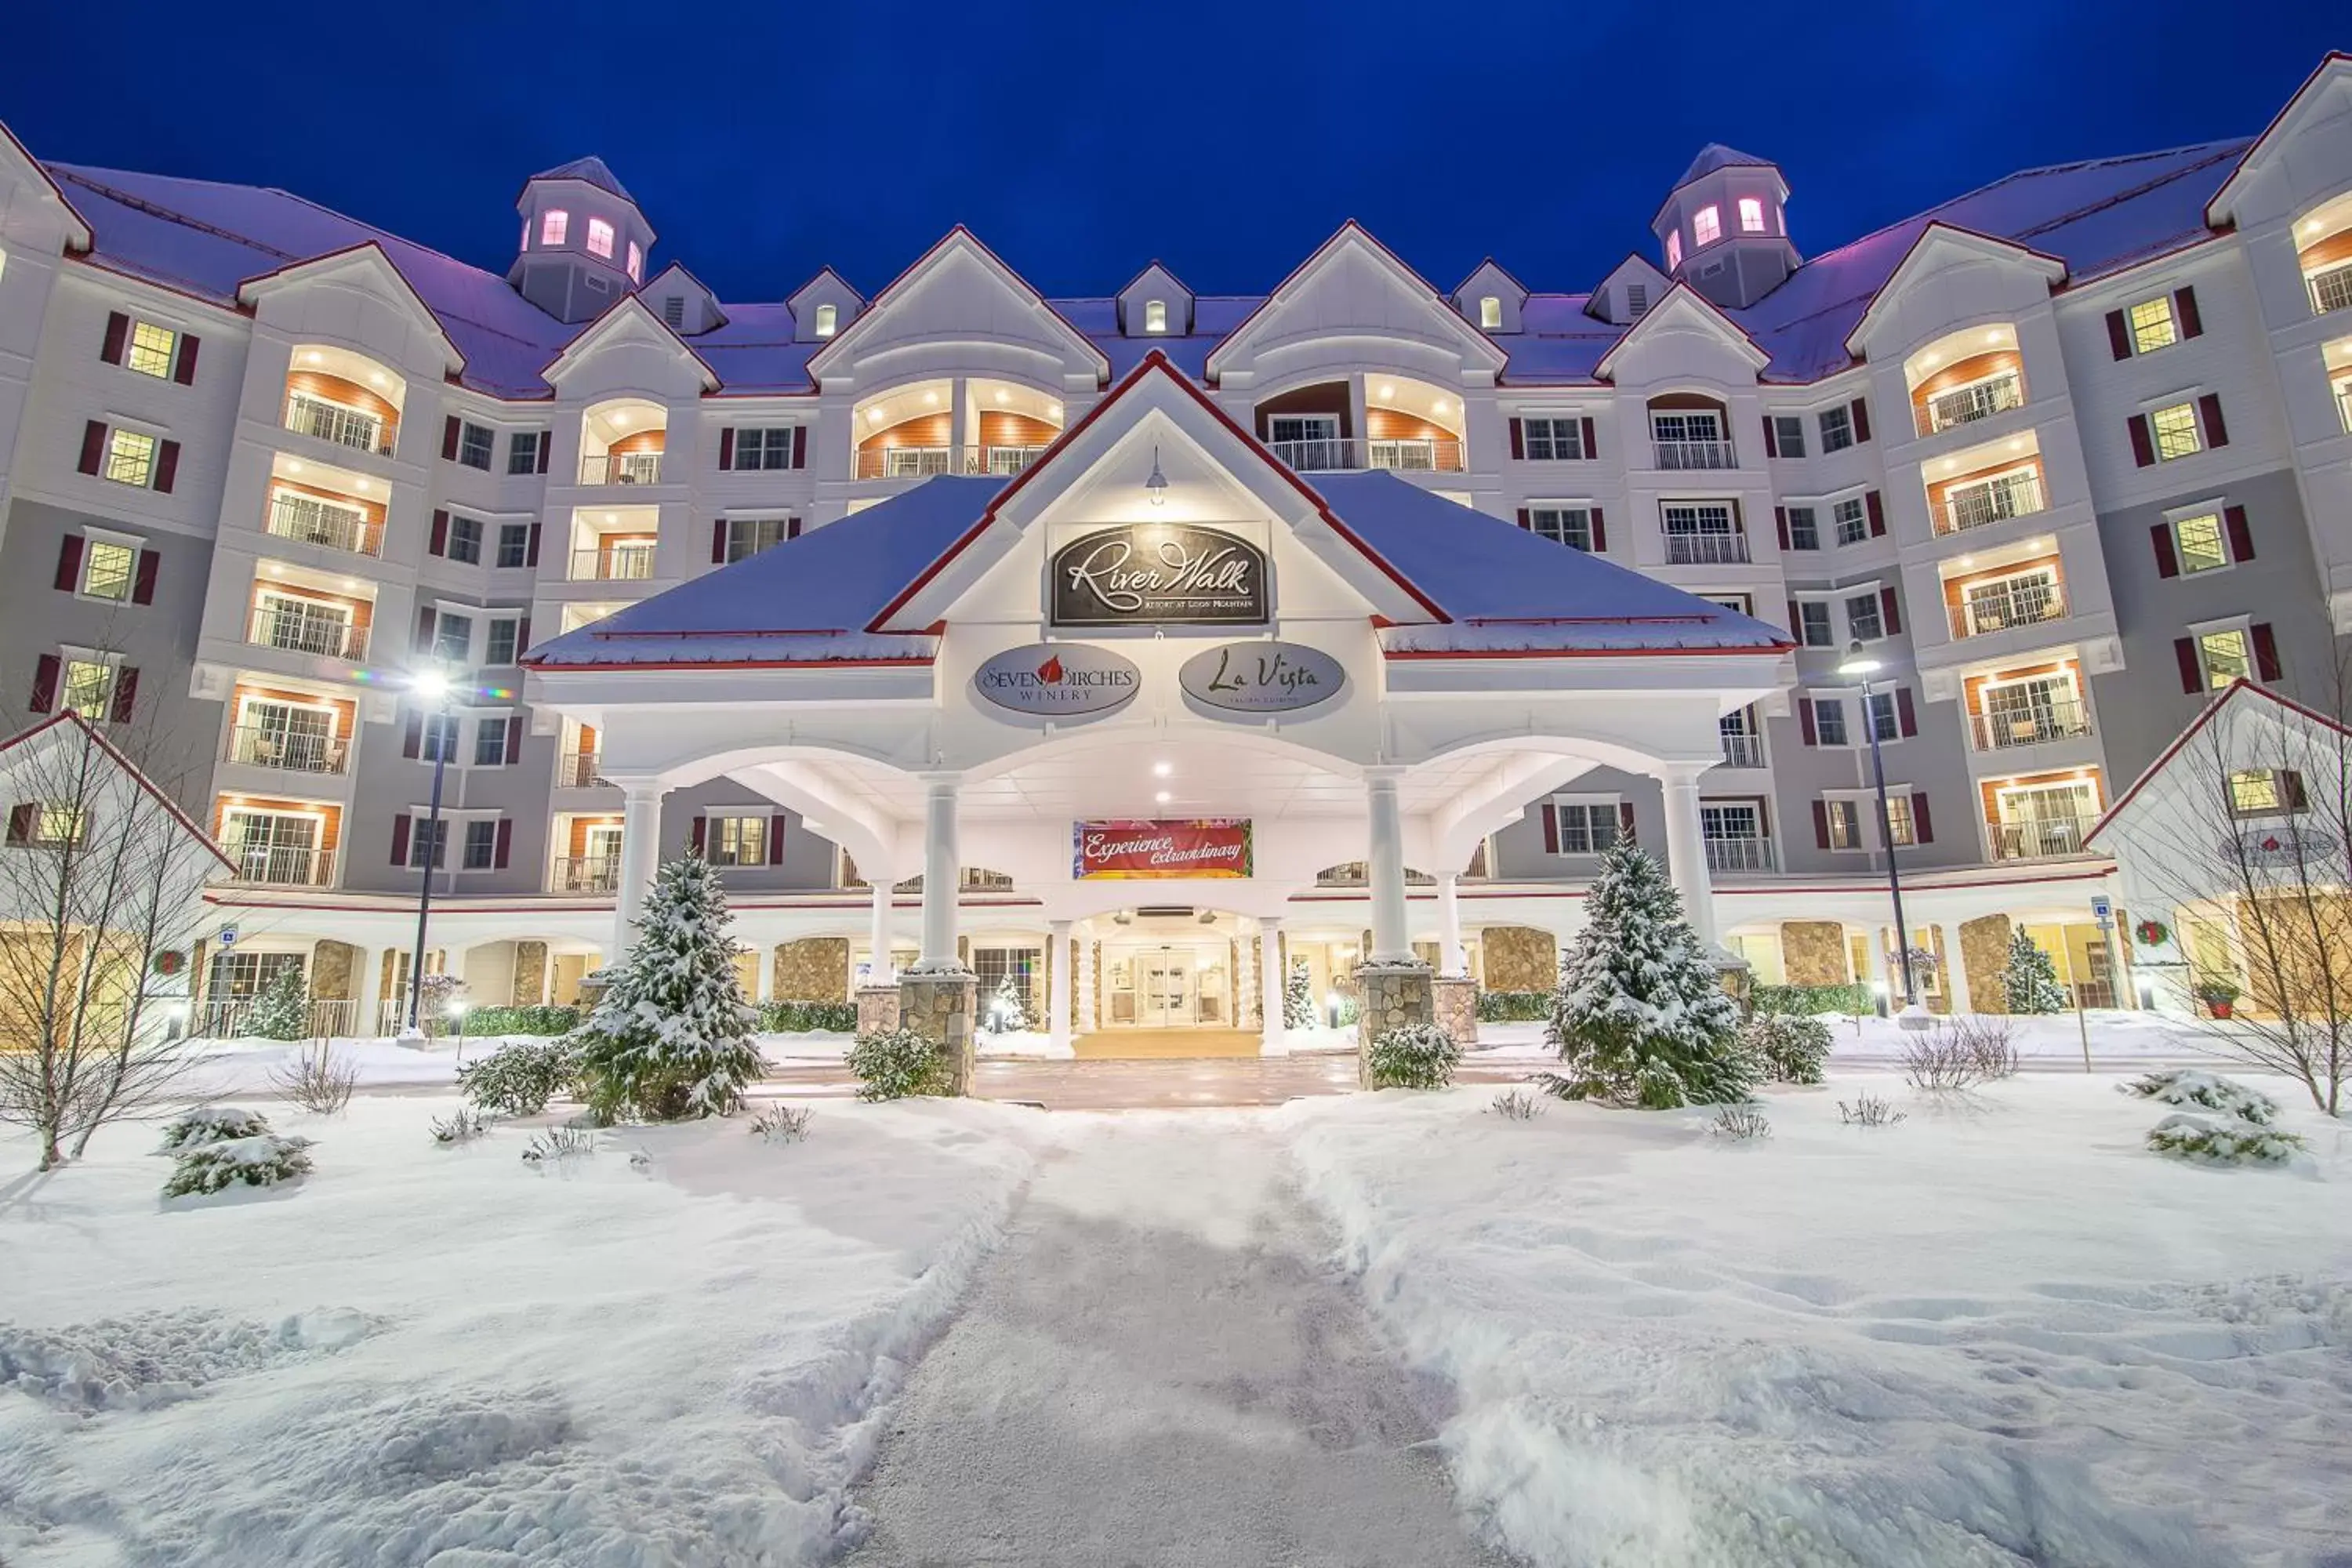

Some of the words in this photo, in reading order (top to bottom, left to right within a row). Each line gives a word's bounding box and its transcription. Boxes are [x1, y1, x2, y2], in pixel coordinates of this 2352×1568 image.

[1068, 541, 1163, 611] River
[1158, 540, 1250, 595] Walk
[982, 667, 1044, 688] SEVEN
[1208, 648, 1247, 691] La
[1258, 653, 1319, 695] Vista
[1020, 689, 1091, 702] WINERY
[1085, 833, 1173, 863] Experience
[1150, 841, 1241, 864] extraordinary
